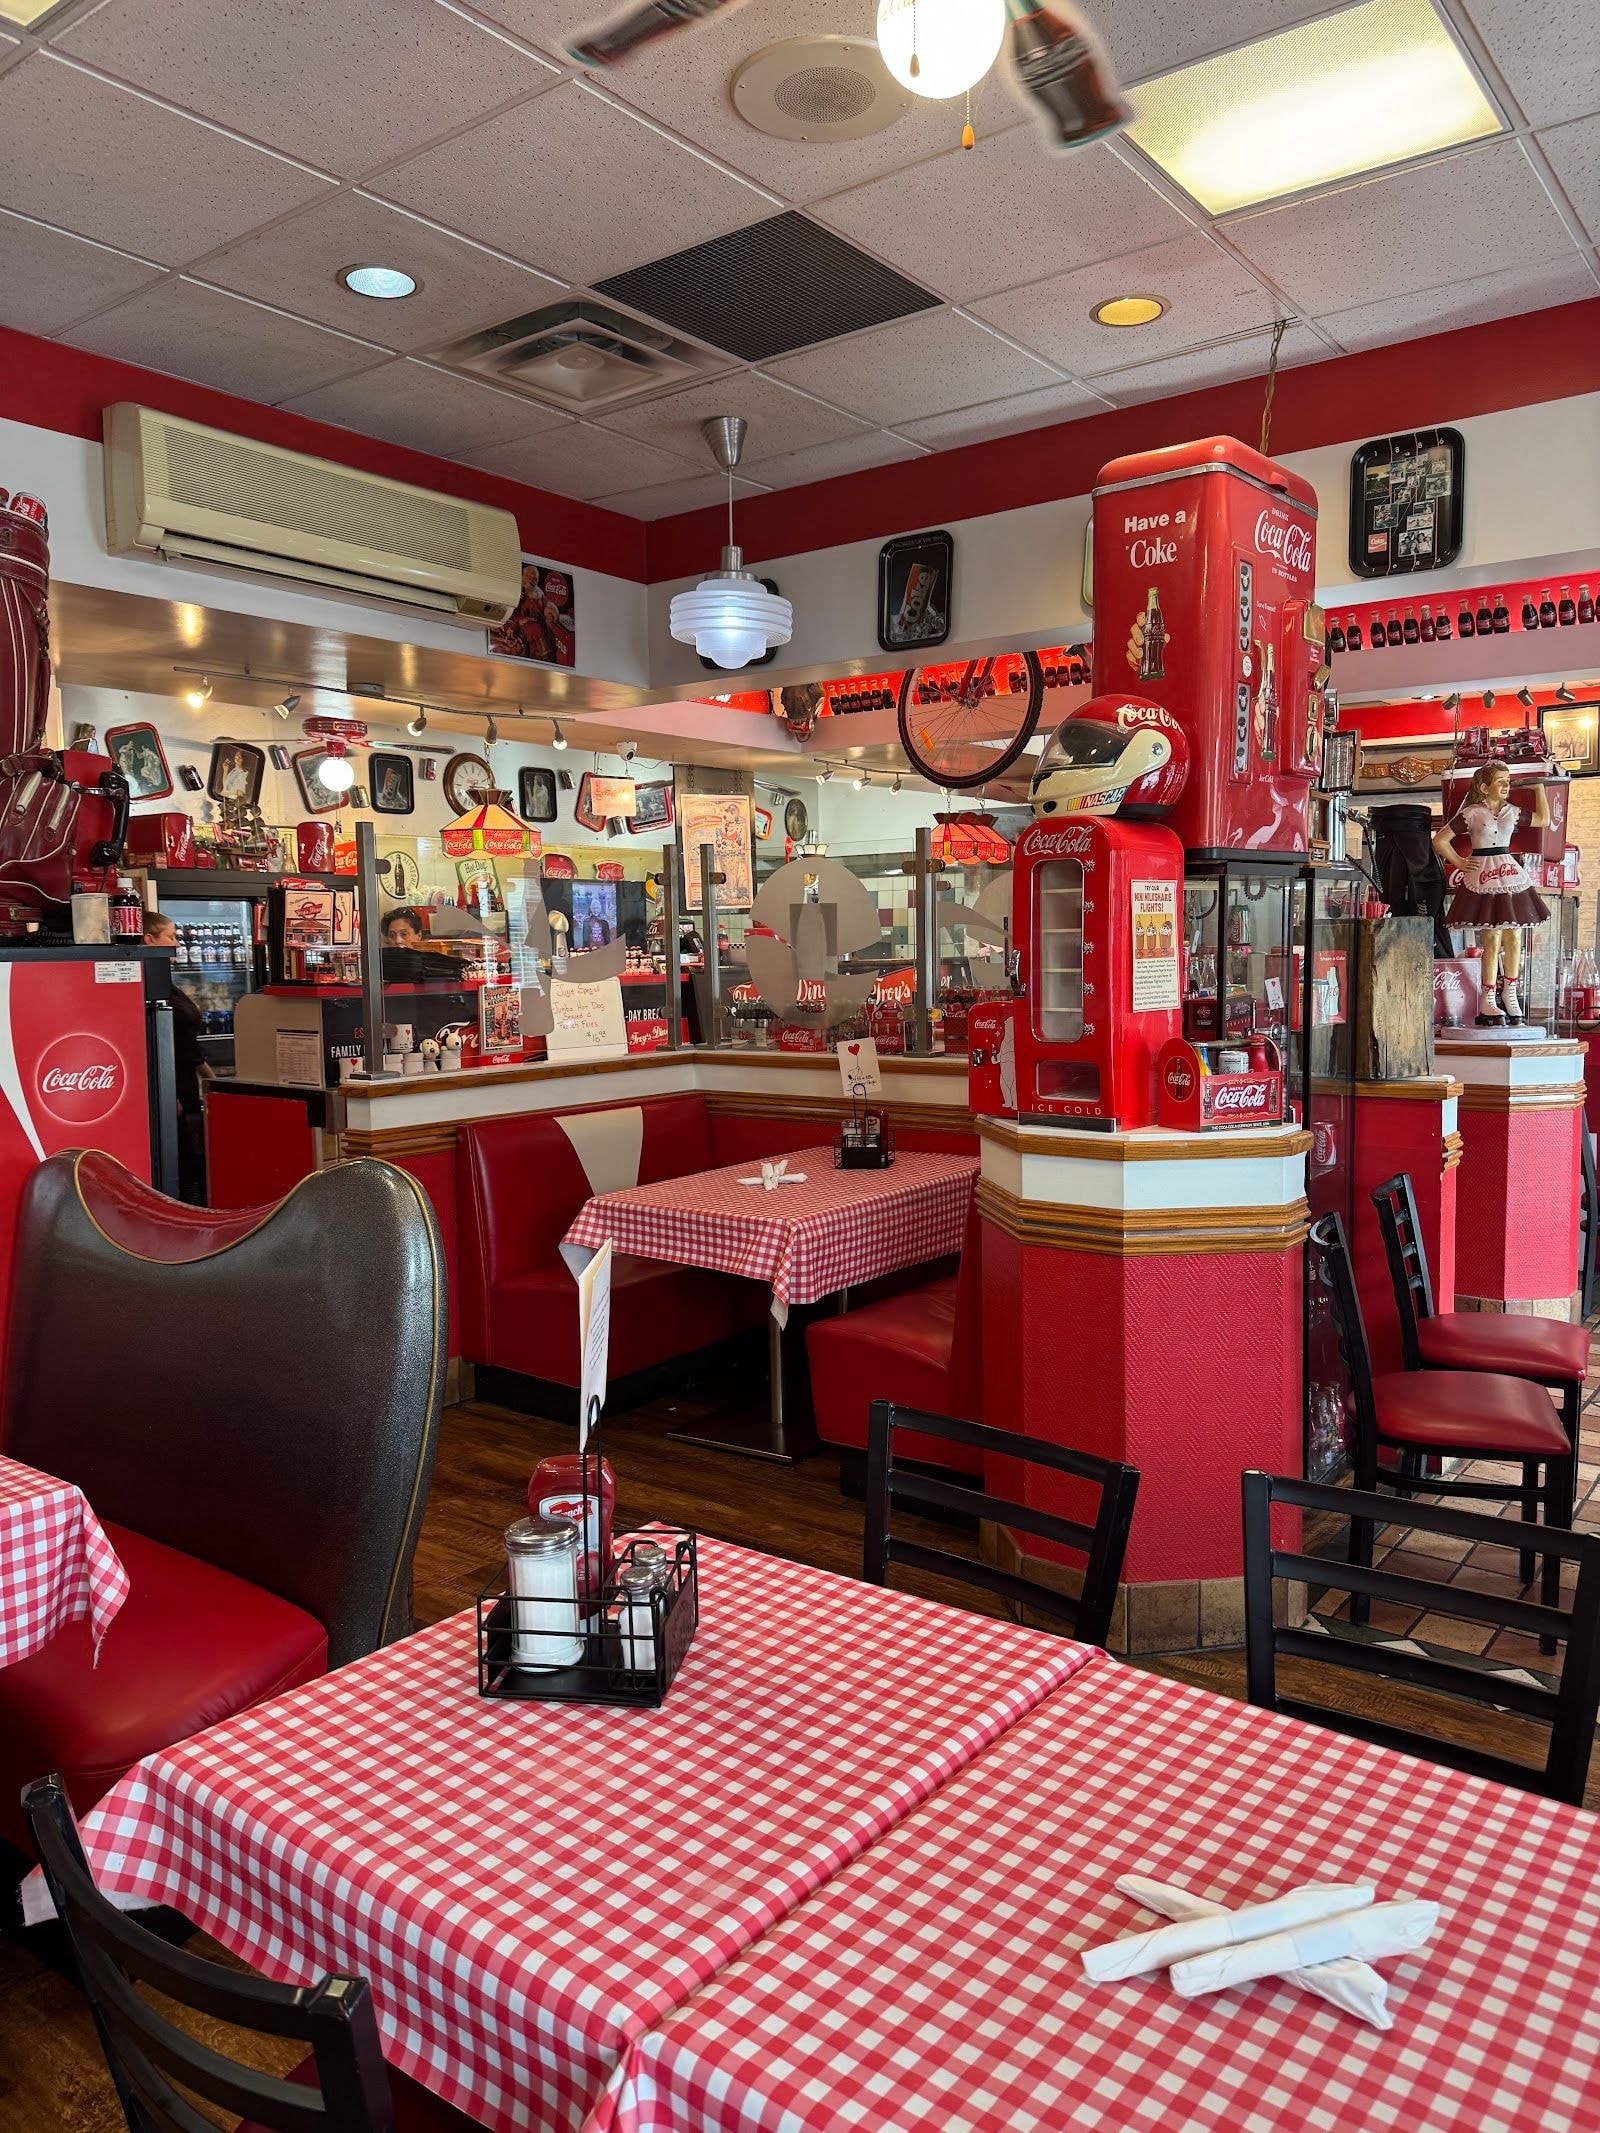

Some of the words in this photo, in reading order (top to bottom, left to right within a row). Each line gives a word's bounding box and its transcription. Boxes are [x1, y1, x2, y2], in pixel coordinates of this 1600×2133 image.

[1124, 515, 1170, 534] Have
[1174, 510, 1186, 524] a
[1271, 507, 1289, 522] DRINK
[1254, 509, 1313, 573] Coca-Cola
[545, 582, 568, 596] Coca-Cola
[1084, 786, 1127, 810] NASCAR
[485, 839, 522, 850] Coca-Cola
[1022, 826, 1096, 856] Coca-Cola
[1479, 862, 1519, 884] Coca-Cola
[1140, 902, 1164, 912] FLIGHTS!
[974, 1019, 996, 1029] Coca-Cola
[782, 1030, 811, 1043] Coca-Cola
[330, 1044, 361, 1059] FAMILY
[42, 1065, 118, 1094] Coca-Cola
[1167, 1072, 1192, 1086] Coca-Cola
[1214, 1084, 1267, 1110] Coca-Cola
[1030, 1103, 1055, 1113] ICE
[1063, 1105, 1102, 1116] COLD
